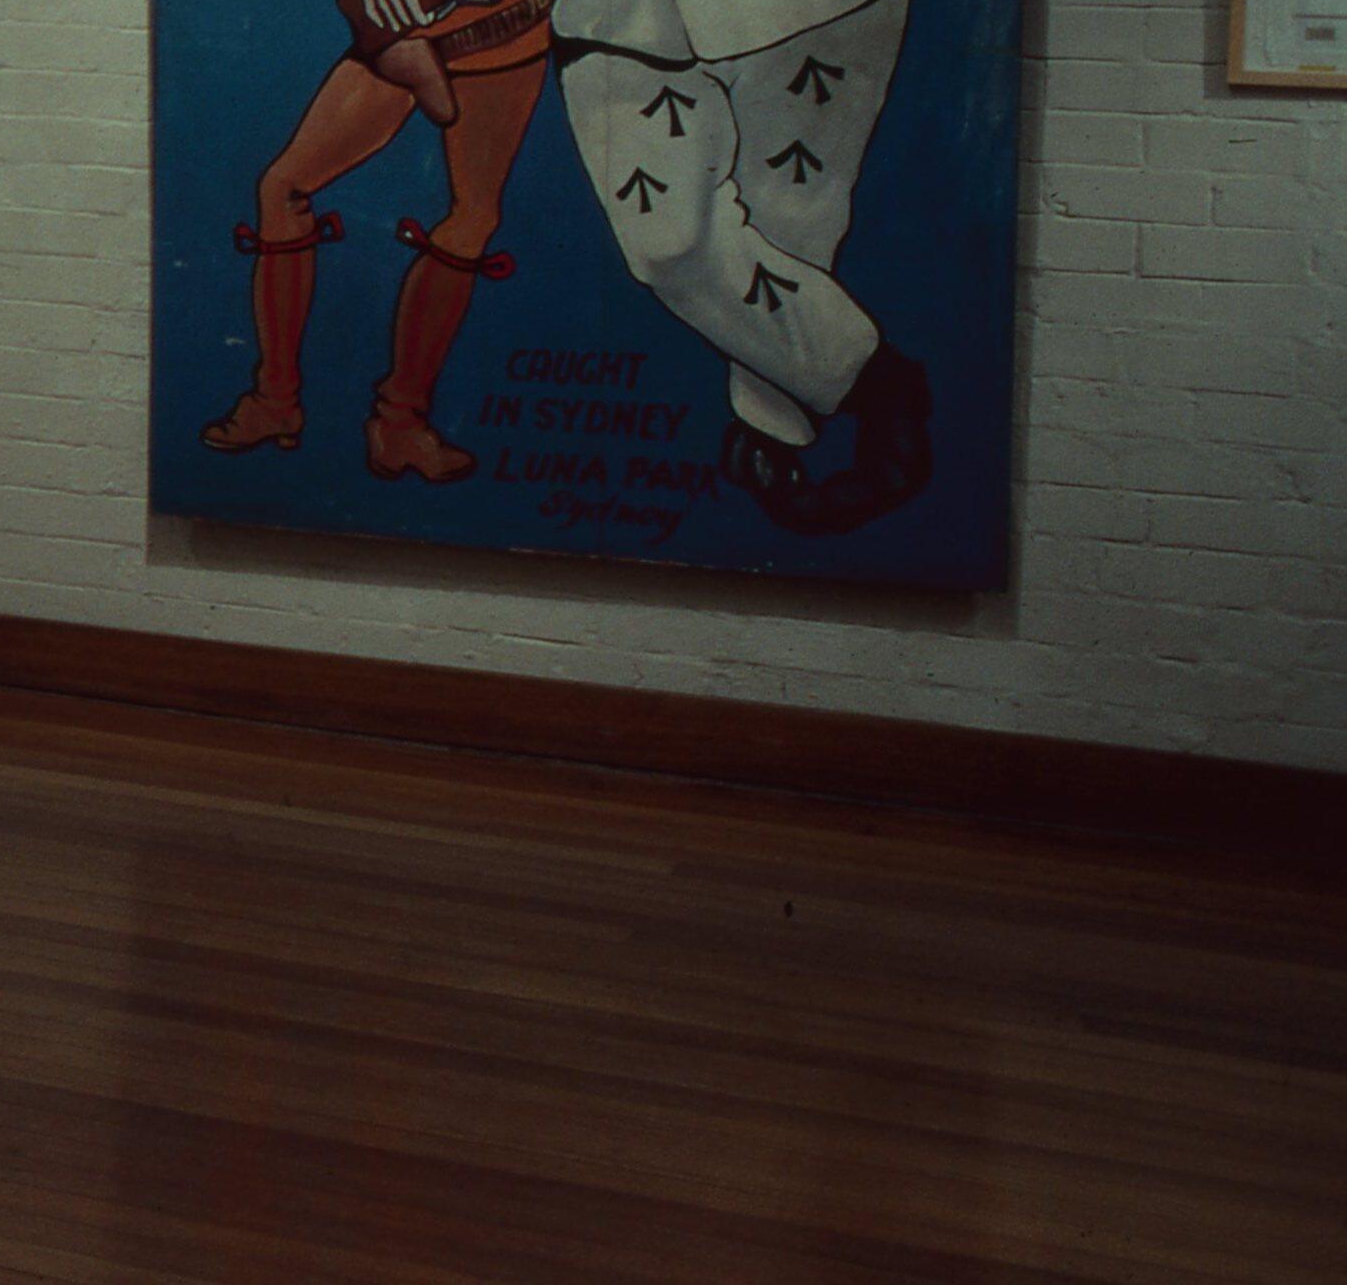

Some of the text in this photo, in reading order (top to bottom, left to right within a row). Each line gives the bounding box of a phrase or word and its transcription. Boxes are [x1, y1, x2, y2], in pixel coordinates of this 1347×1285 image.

[507, 347, 650, 391] CAUGHT
[477, 393, 693, 443] IN SYDNEY
[493, 445, 721, 503] LUNA PARK
